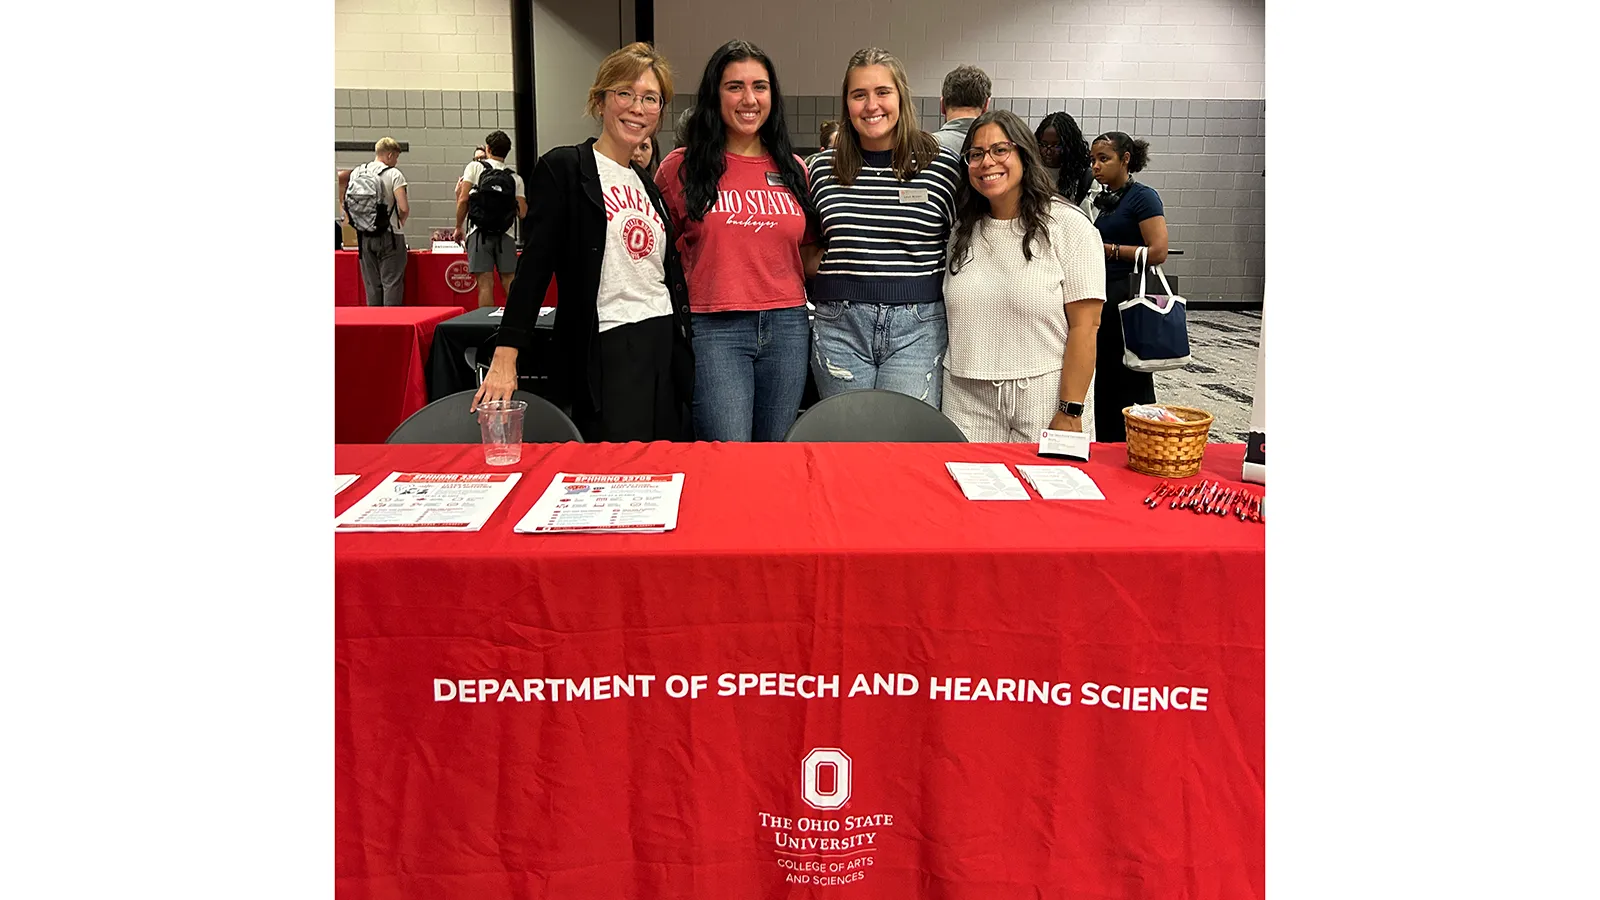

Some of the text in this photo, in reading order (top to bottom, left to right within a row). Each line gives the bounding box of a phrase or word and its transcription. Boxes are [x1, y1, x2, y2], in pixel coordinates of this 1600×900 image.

[707, 189, 801, 216] HIO STATE
[725, 213, 778, 233] buckeyes
[630, 228, 646, 250] O
[433, 673, 1209, 711] DEPARTMENT OF SPEECH AND HEARING SCIENCE
[801, 747, 852, 811] O
[777, 856, 874, 873] COLLEGE OF ARTS
[786, 871, 865, 887] AND SCIENCES
